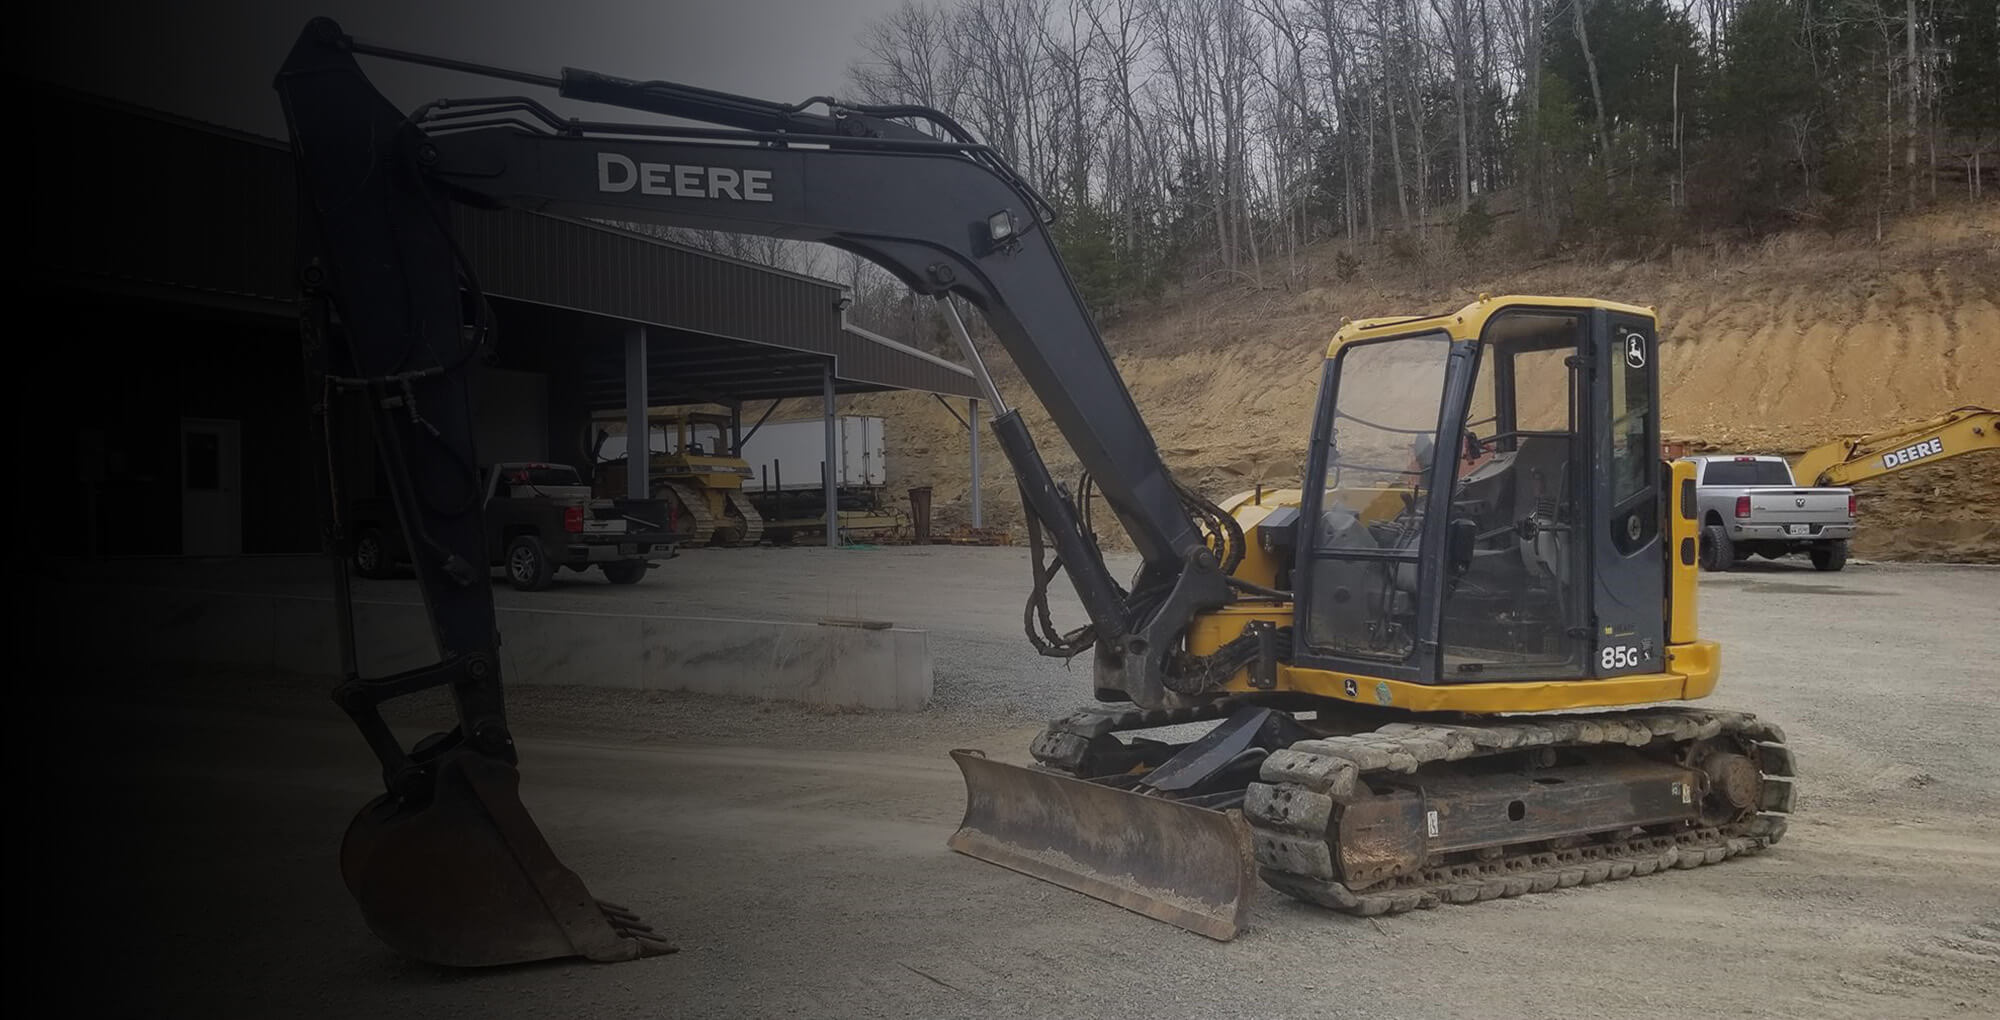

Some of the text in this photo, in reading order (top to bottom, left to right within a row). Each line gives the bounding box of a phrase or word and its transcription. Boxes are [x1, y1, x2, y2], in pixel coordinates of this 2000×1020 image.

[597, 152, 773, 202] DEERE
[1882, 438, 1942, 468] DEERE
[1601, 646, 1638, 669] 85G
